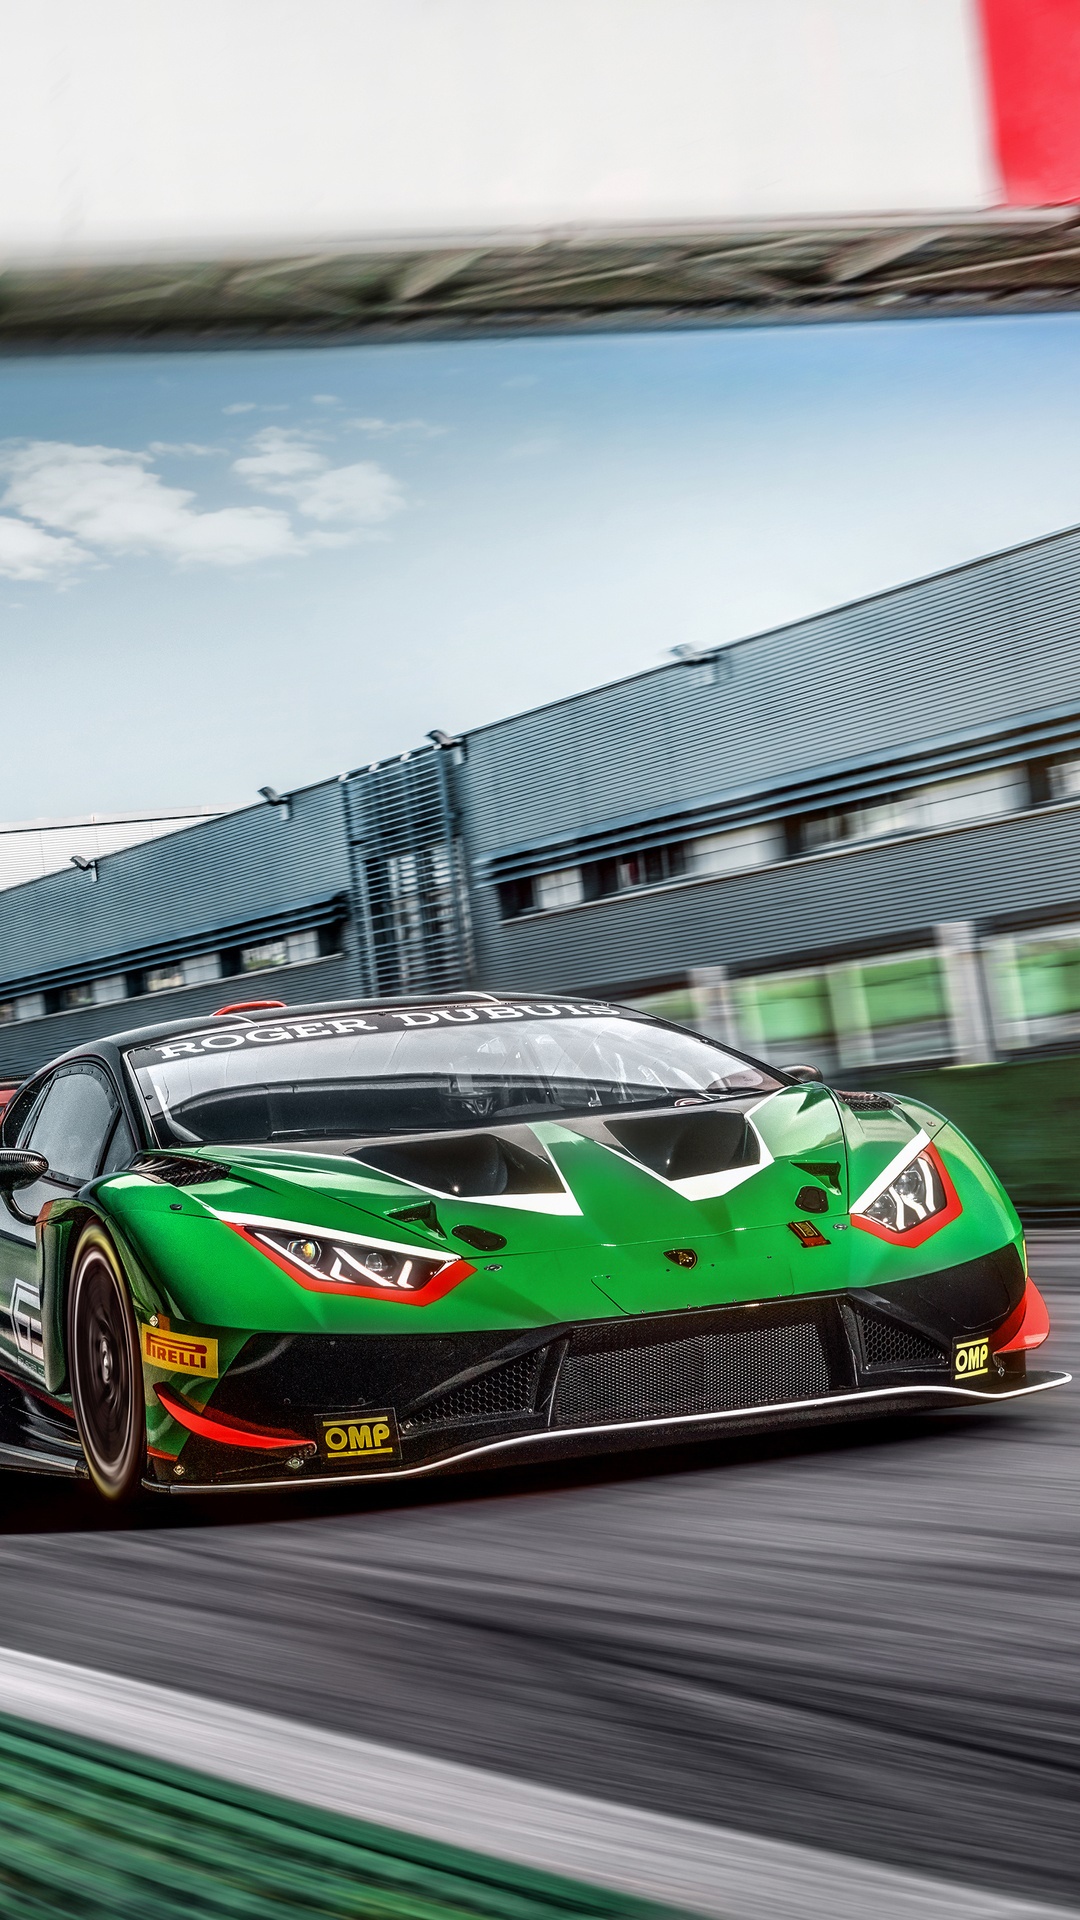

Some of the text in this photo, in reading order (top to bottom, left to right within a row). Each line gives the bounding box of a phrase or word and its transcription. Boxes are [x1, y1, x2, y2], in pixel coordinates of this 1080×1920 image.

[155, 1004, 620, 1059] ROGER DUBUIS
[146, 1332, 207, 1369] PIRELLI
[955, 1344, 988, 1372] OMP
[325, 1423, 390, 1451] OMP
